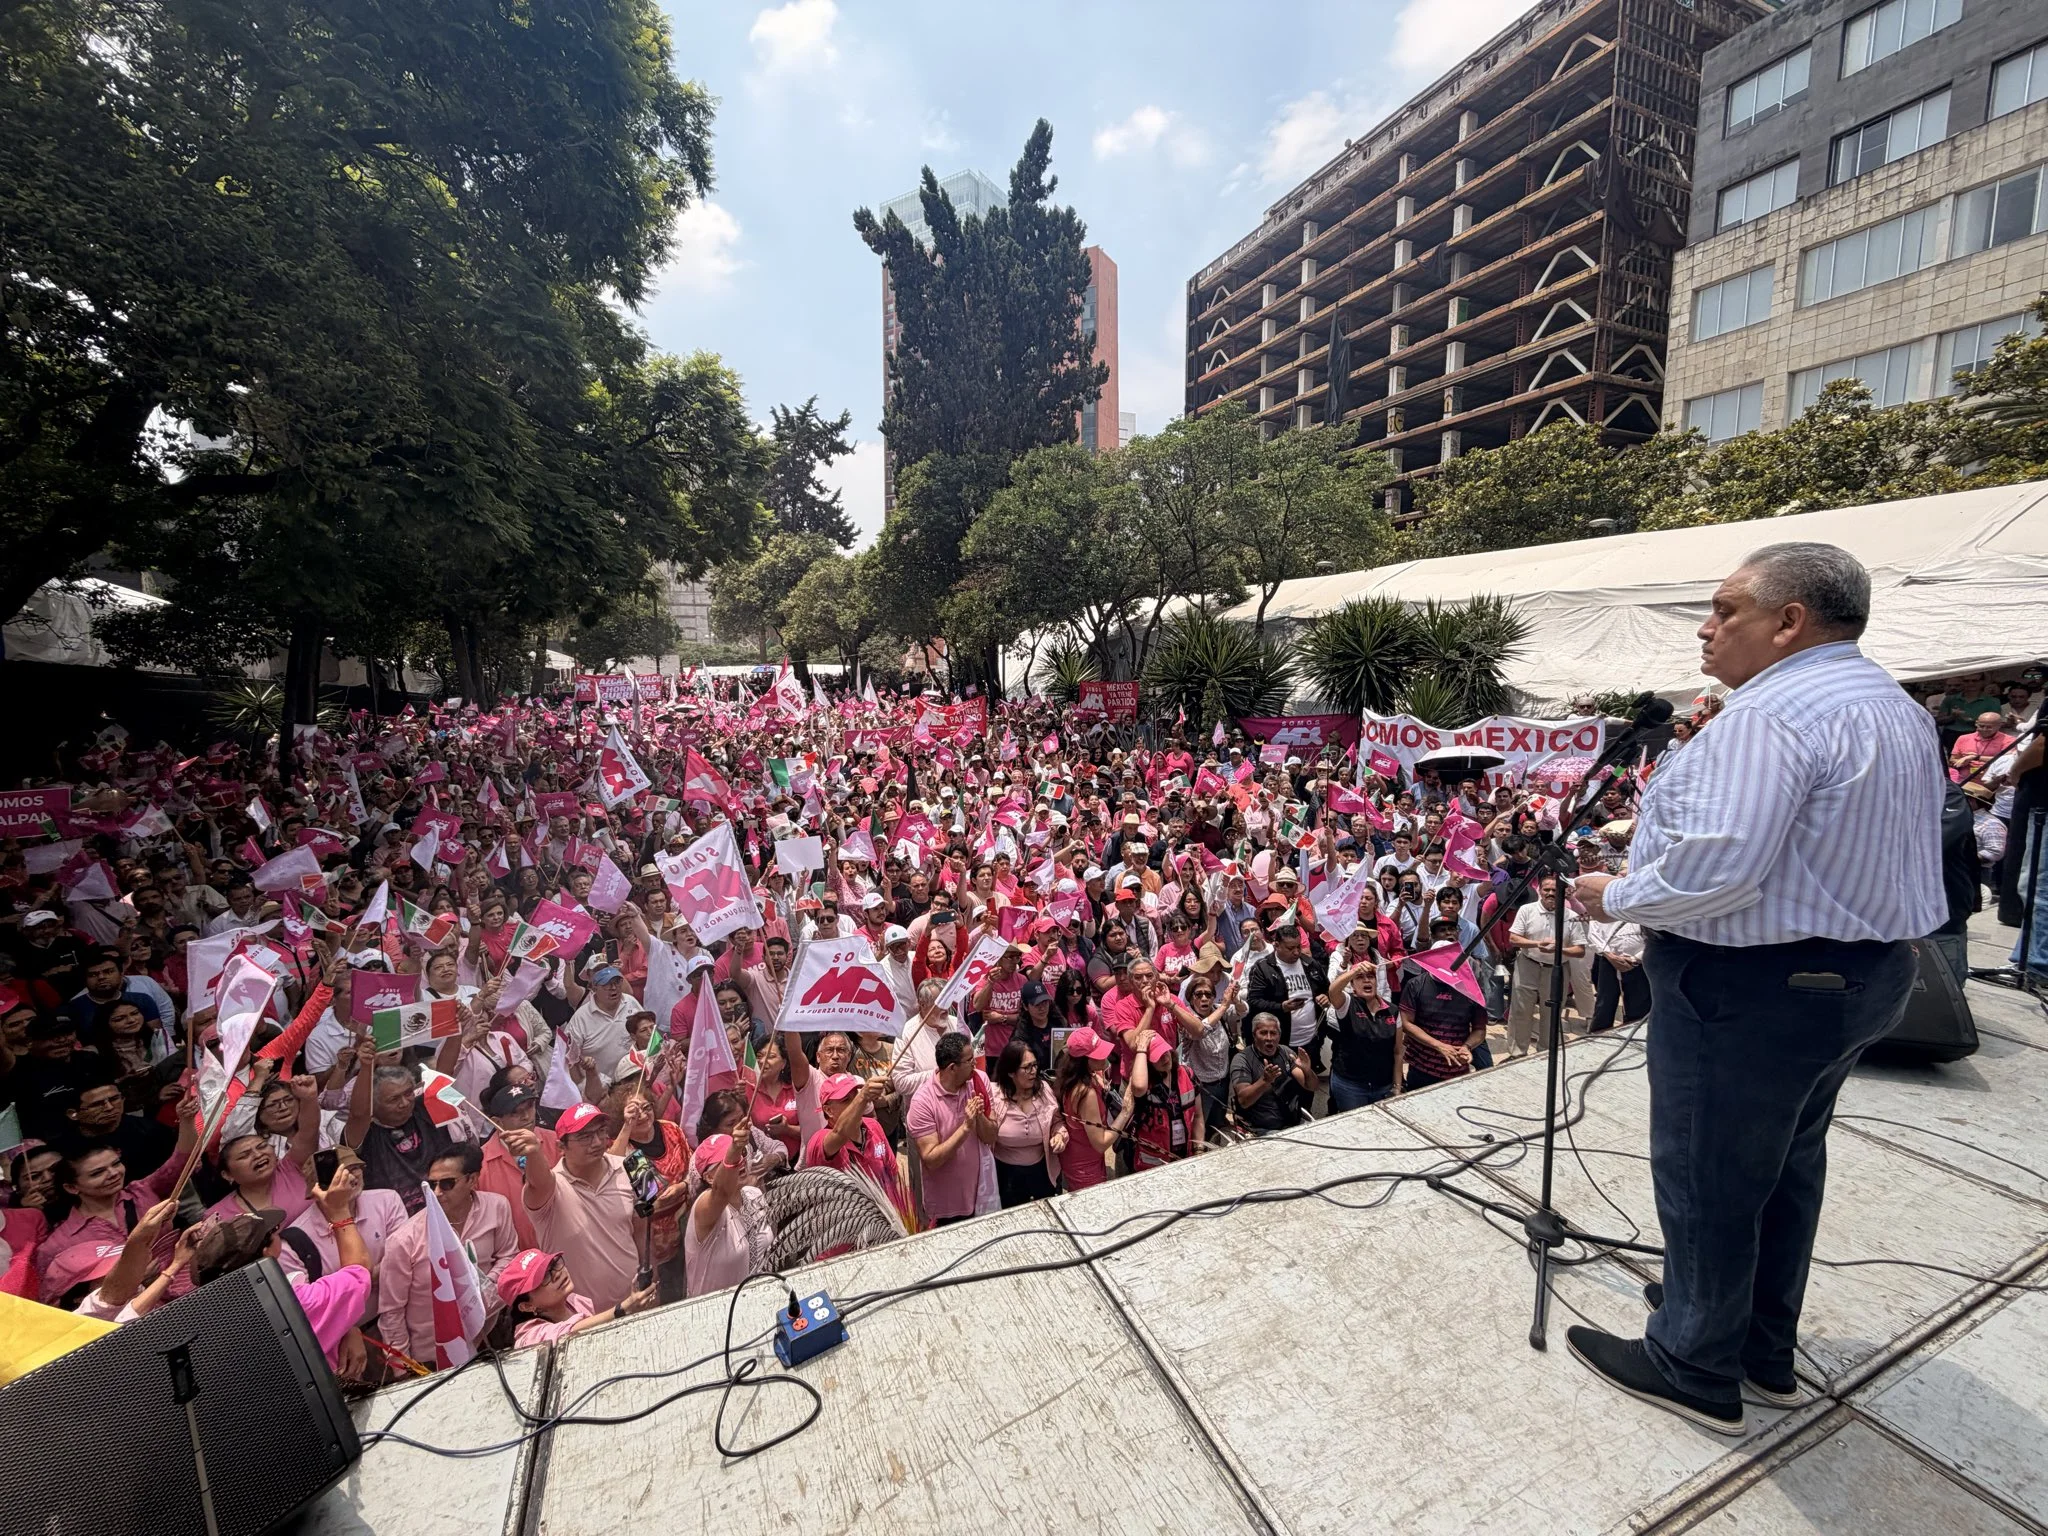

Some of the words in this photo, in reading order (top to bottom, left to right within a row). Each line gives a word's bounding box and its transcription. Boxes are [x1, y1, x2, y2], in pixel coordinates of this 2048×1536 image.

[1107, 697, 1136, 707] PARTIDO
[1454, 725, 1599, 753] MEXICO
[858, 1008, 875, 1016] NOS
[876, 1012, 892, 1021] UNE
